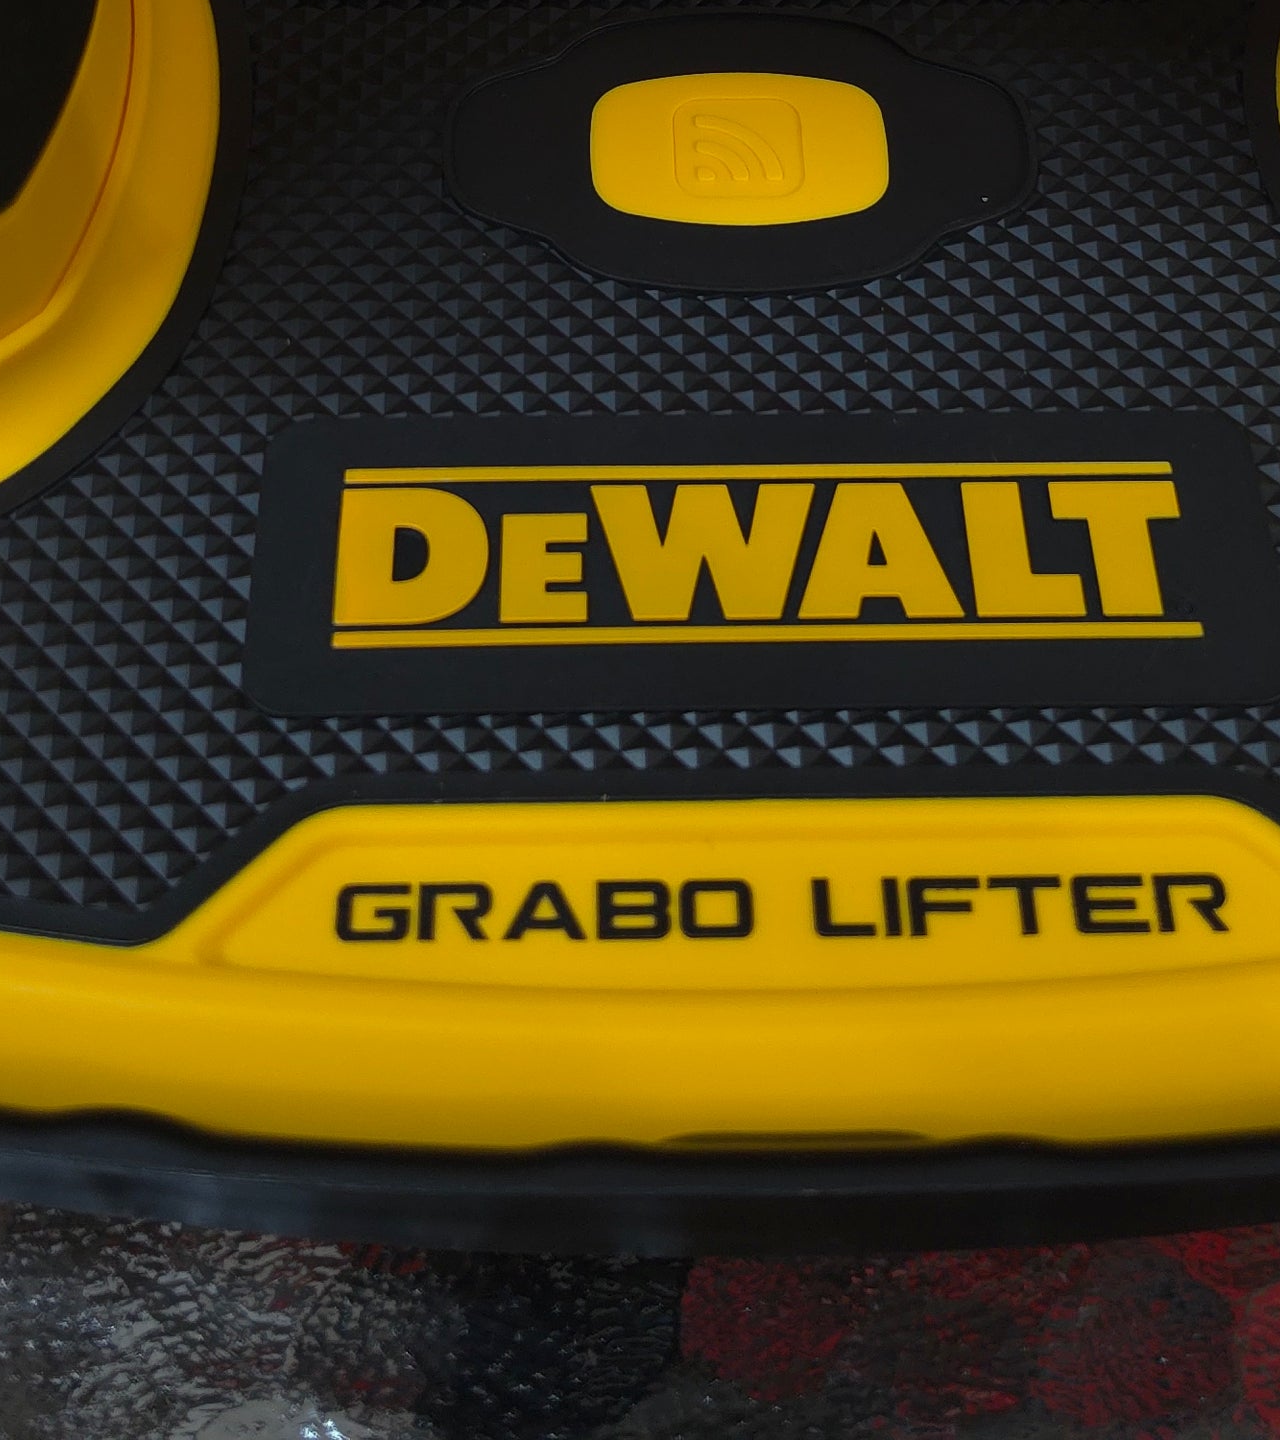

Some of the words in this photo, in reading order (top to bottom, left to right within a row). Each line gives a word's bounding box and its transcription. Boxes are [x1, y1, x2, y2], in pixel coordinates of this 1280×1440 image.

[332, 480, 1180, 624] DEWALT
[334, 877, 755, 941] GRABO
[811, 873, 1230, 937] LIFTER
